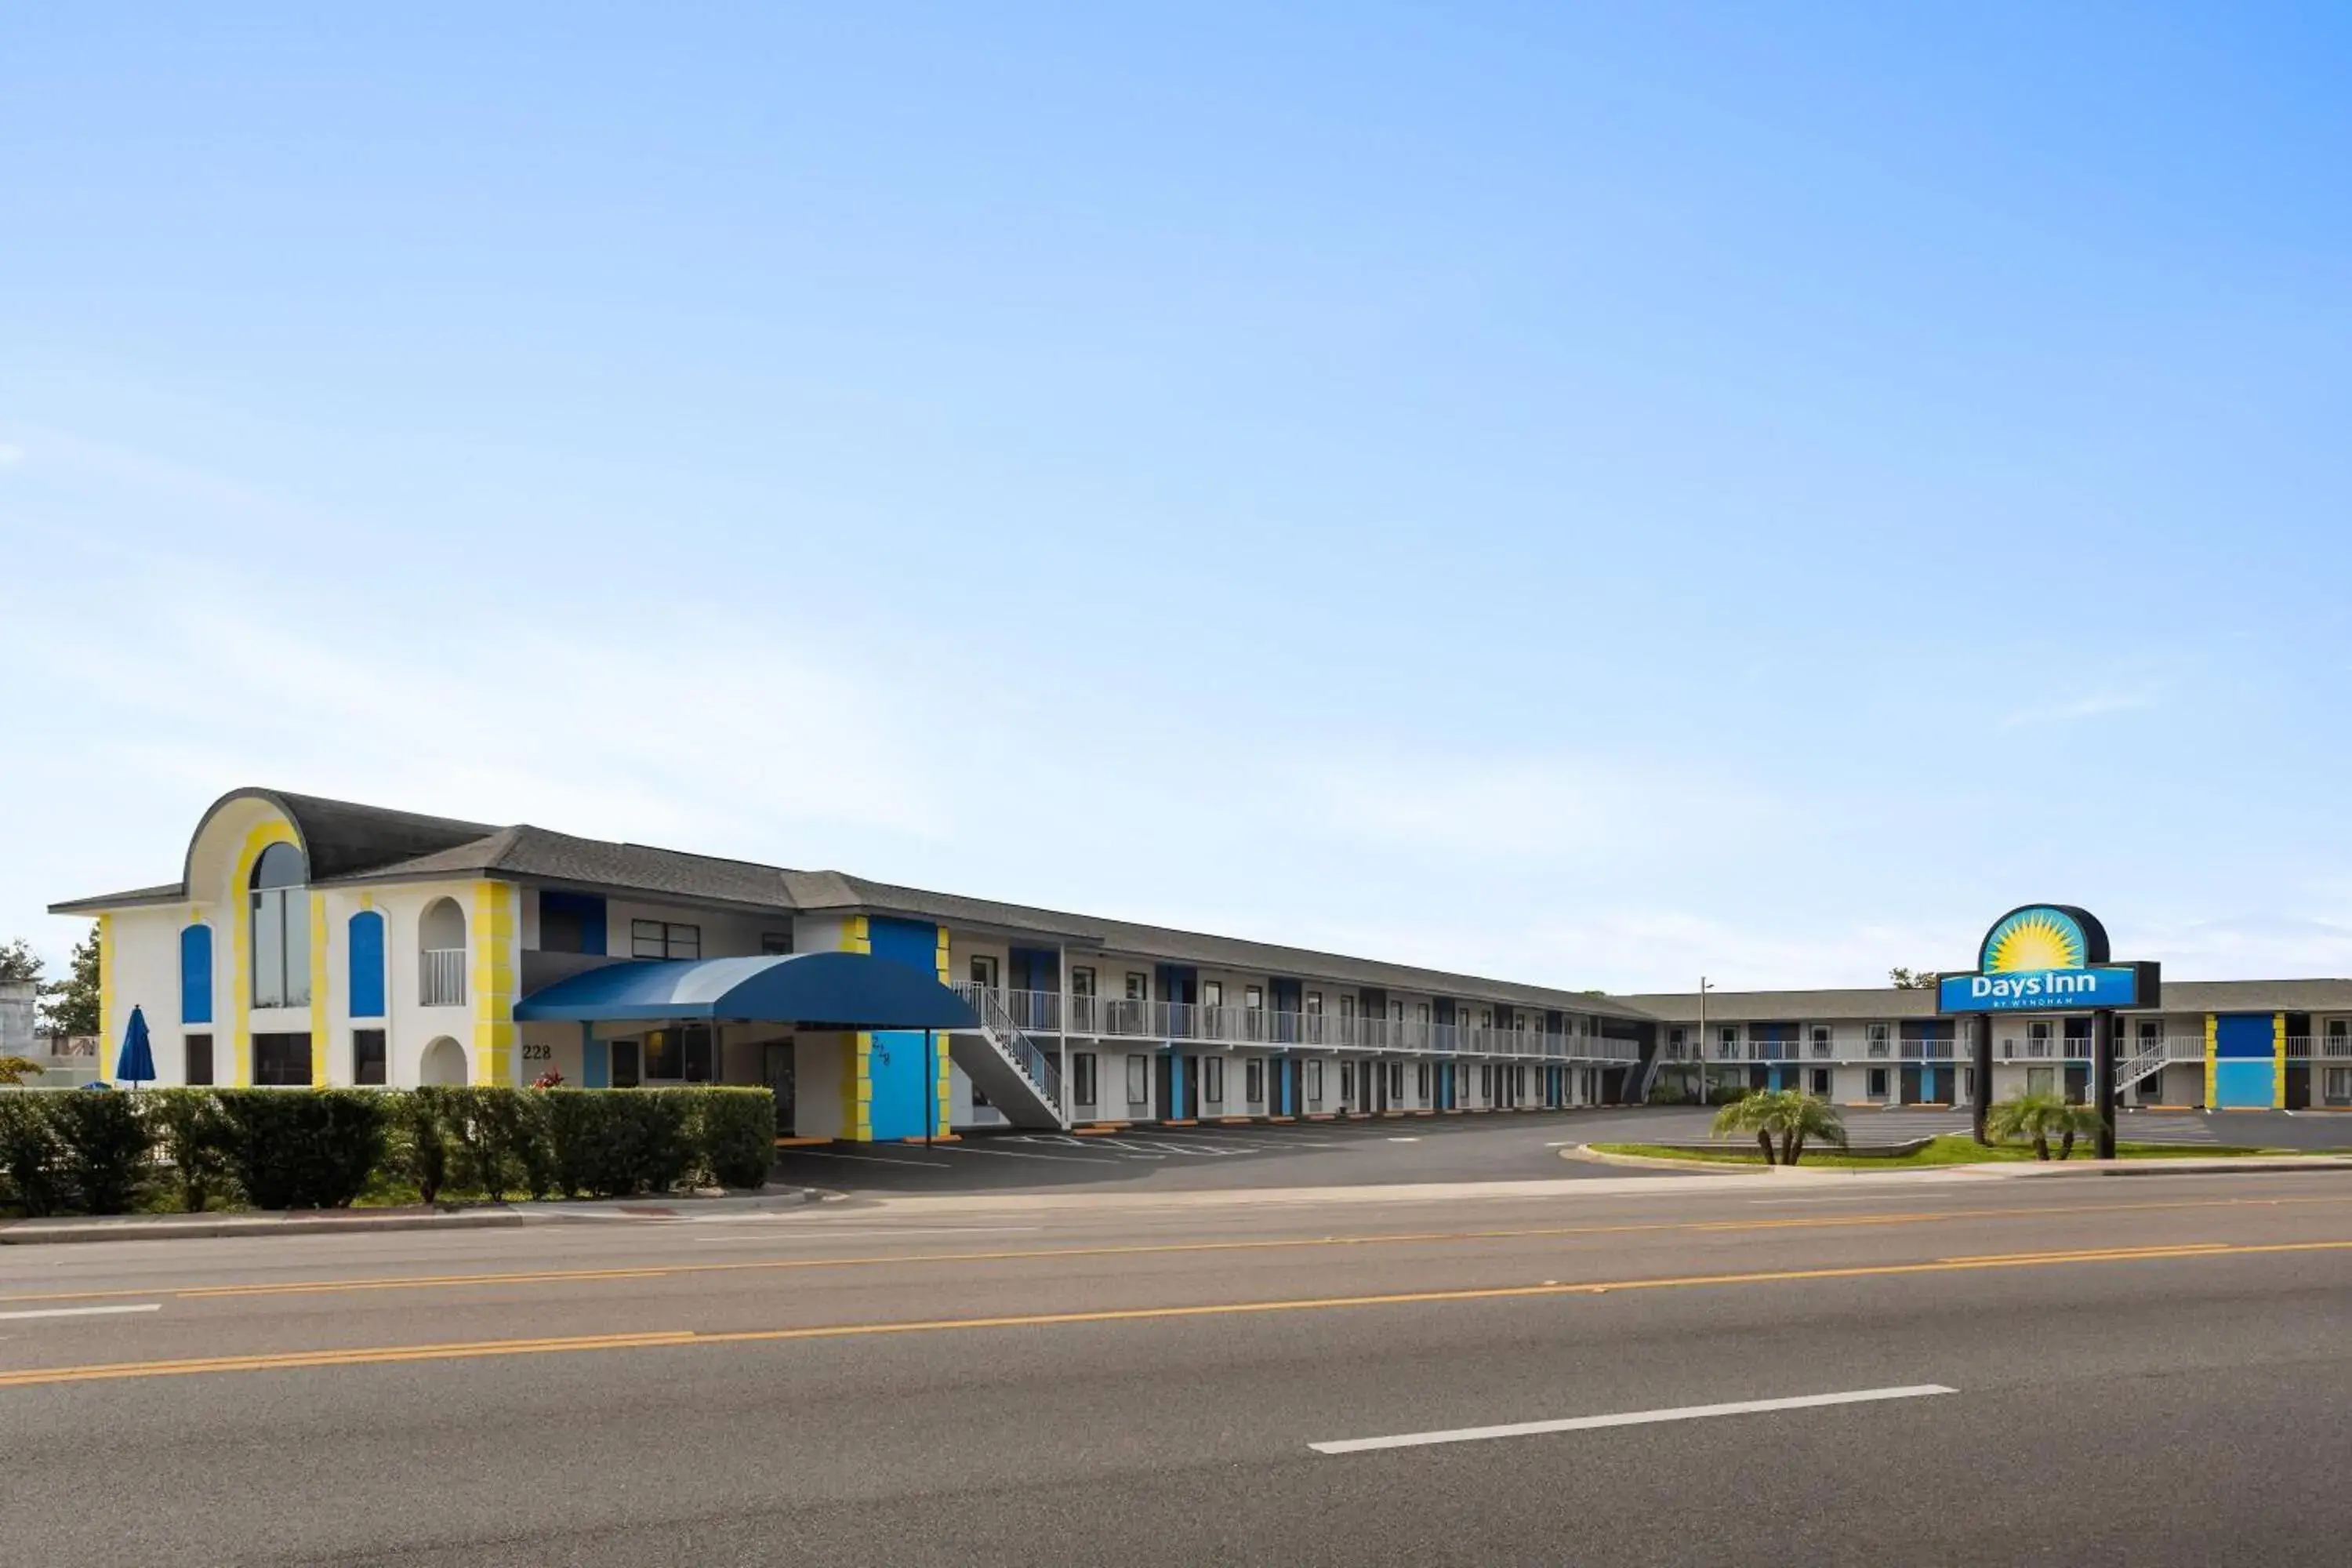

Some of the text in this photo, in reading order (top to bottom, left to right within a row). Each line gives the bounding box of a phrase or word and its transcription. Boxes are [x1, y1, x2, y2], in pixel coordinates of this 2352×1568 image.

[1972, 973, 2096, 998] Days Inn
[522, 1044, 551, 1060] 228
